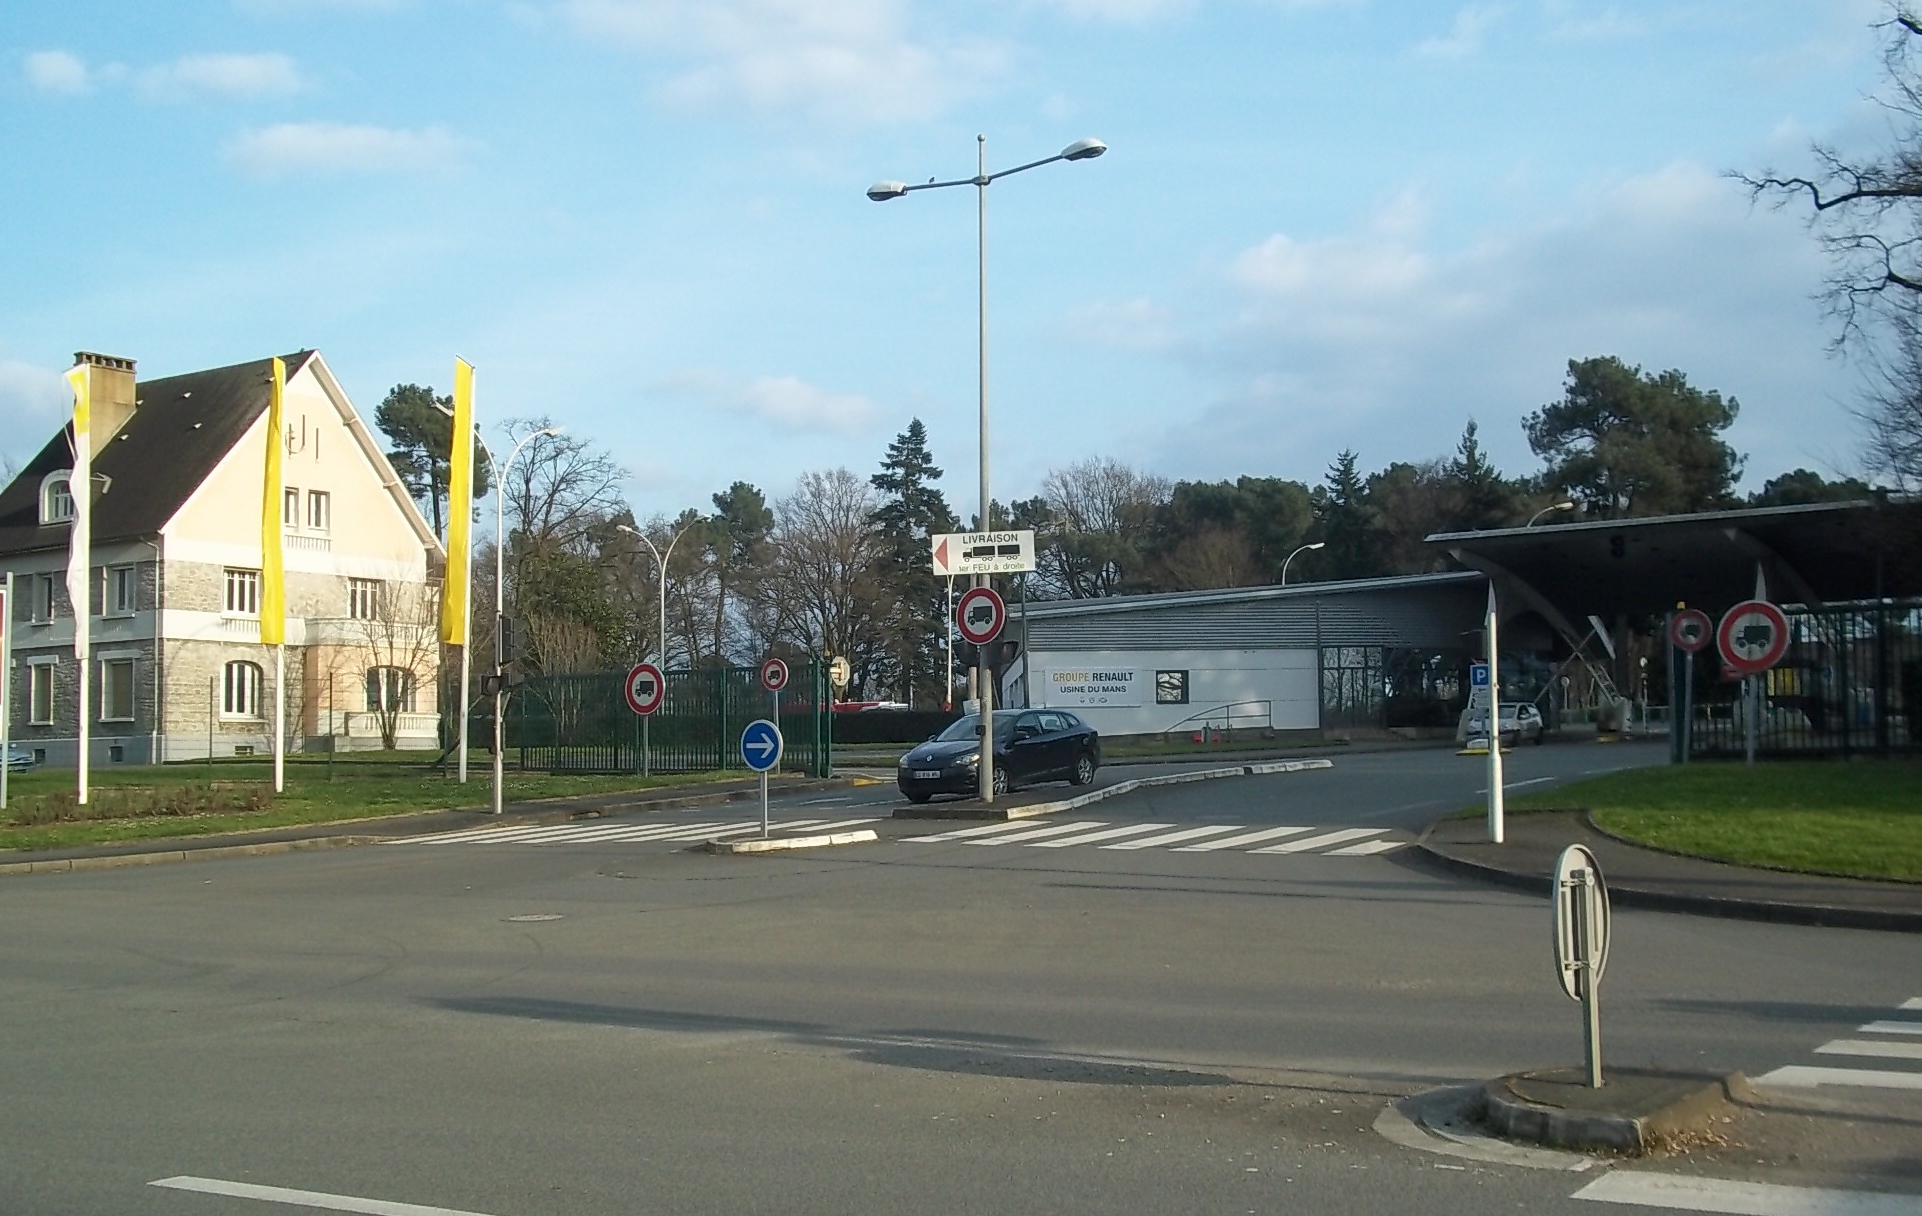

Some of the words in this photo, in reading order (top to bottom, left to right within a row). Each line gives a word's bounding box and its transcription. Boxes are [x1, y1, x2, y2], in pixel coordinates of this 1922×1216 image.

[962, 533, 1018, 544] LIVRAISON
[973, 563, 990, 571] FEU
[1003, 562, 1025, 570] droite
[1052, 672, 1090, 682] GROUPE
[1092, 672, 1134, 682] RENAULT
[1476, 669, 1486, 682] P
